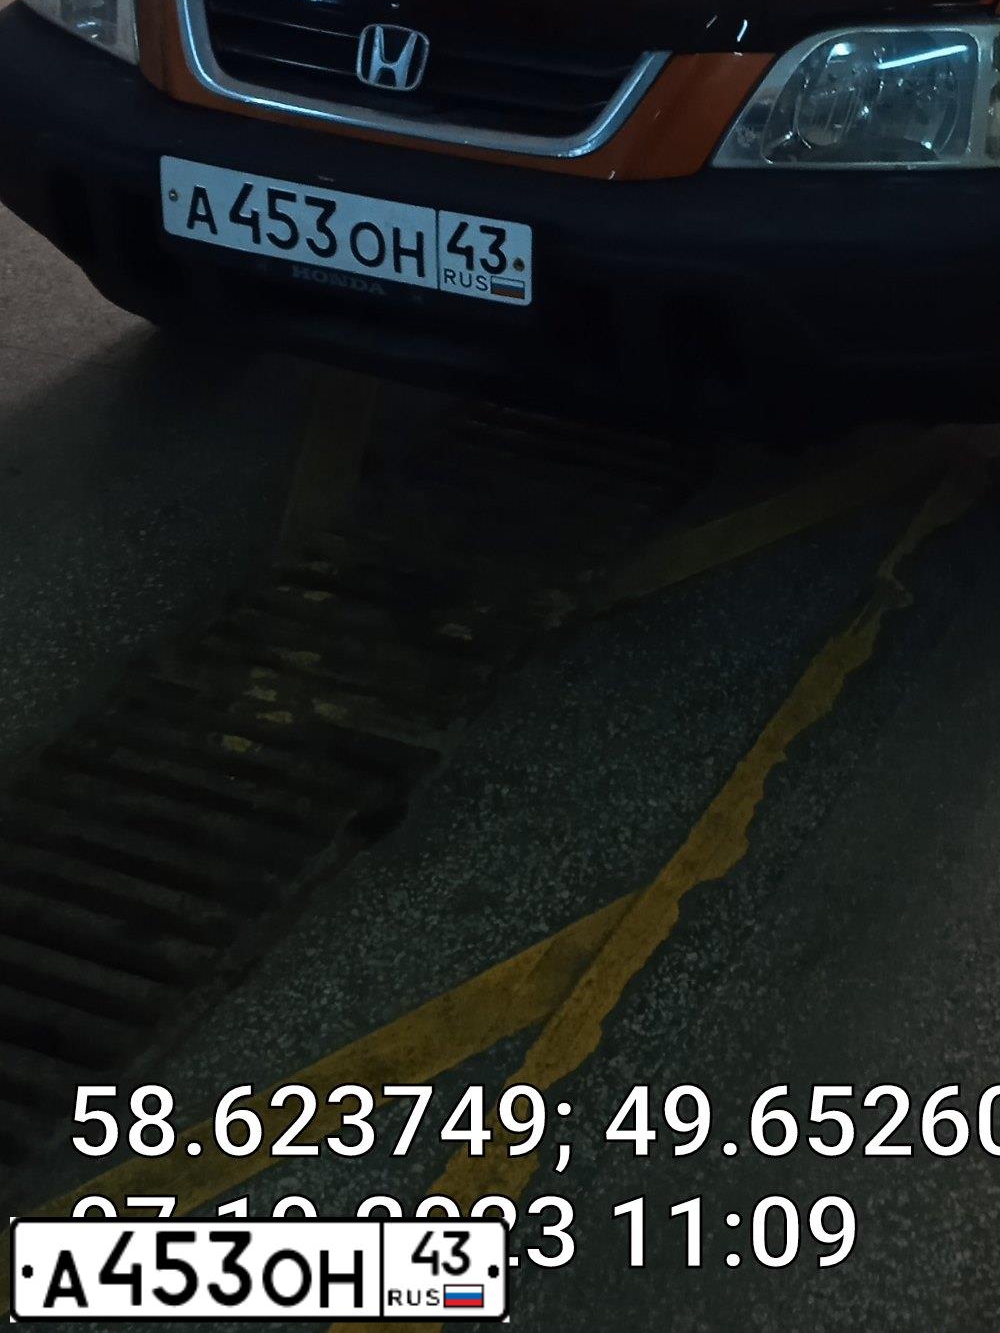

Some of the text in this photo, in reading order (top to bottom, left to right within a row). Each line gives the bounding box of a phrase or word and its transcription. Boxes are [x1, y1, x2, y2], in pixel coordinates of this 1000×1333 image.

[446, 220, 507, 275] 43
[291, 265, 387, 296] HONDA
[443, 267, 490, 293] RUS
